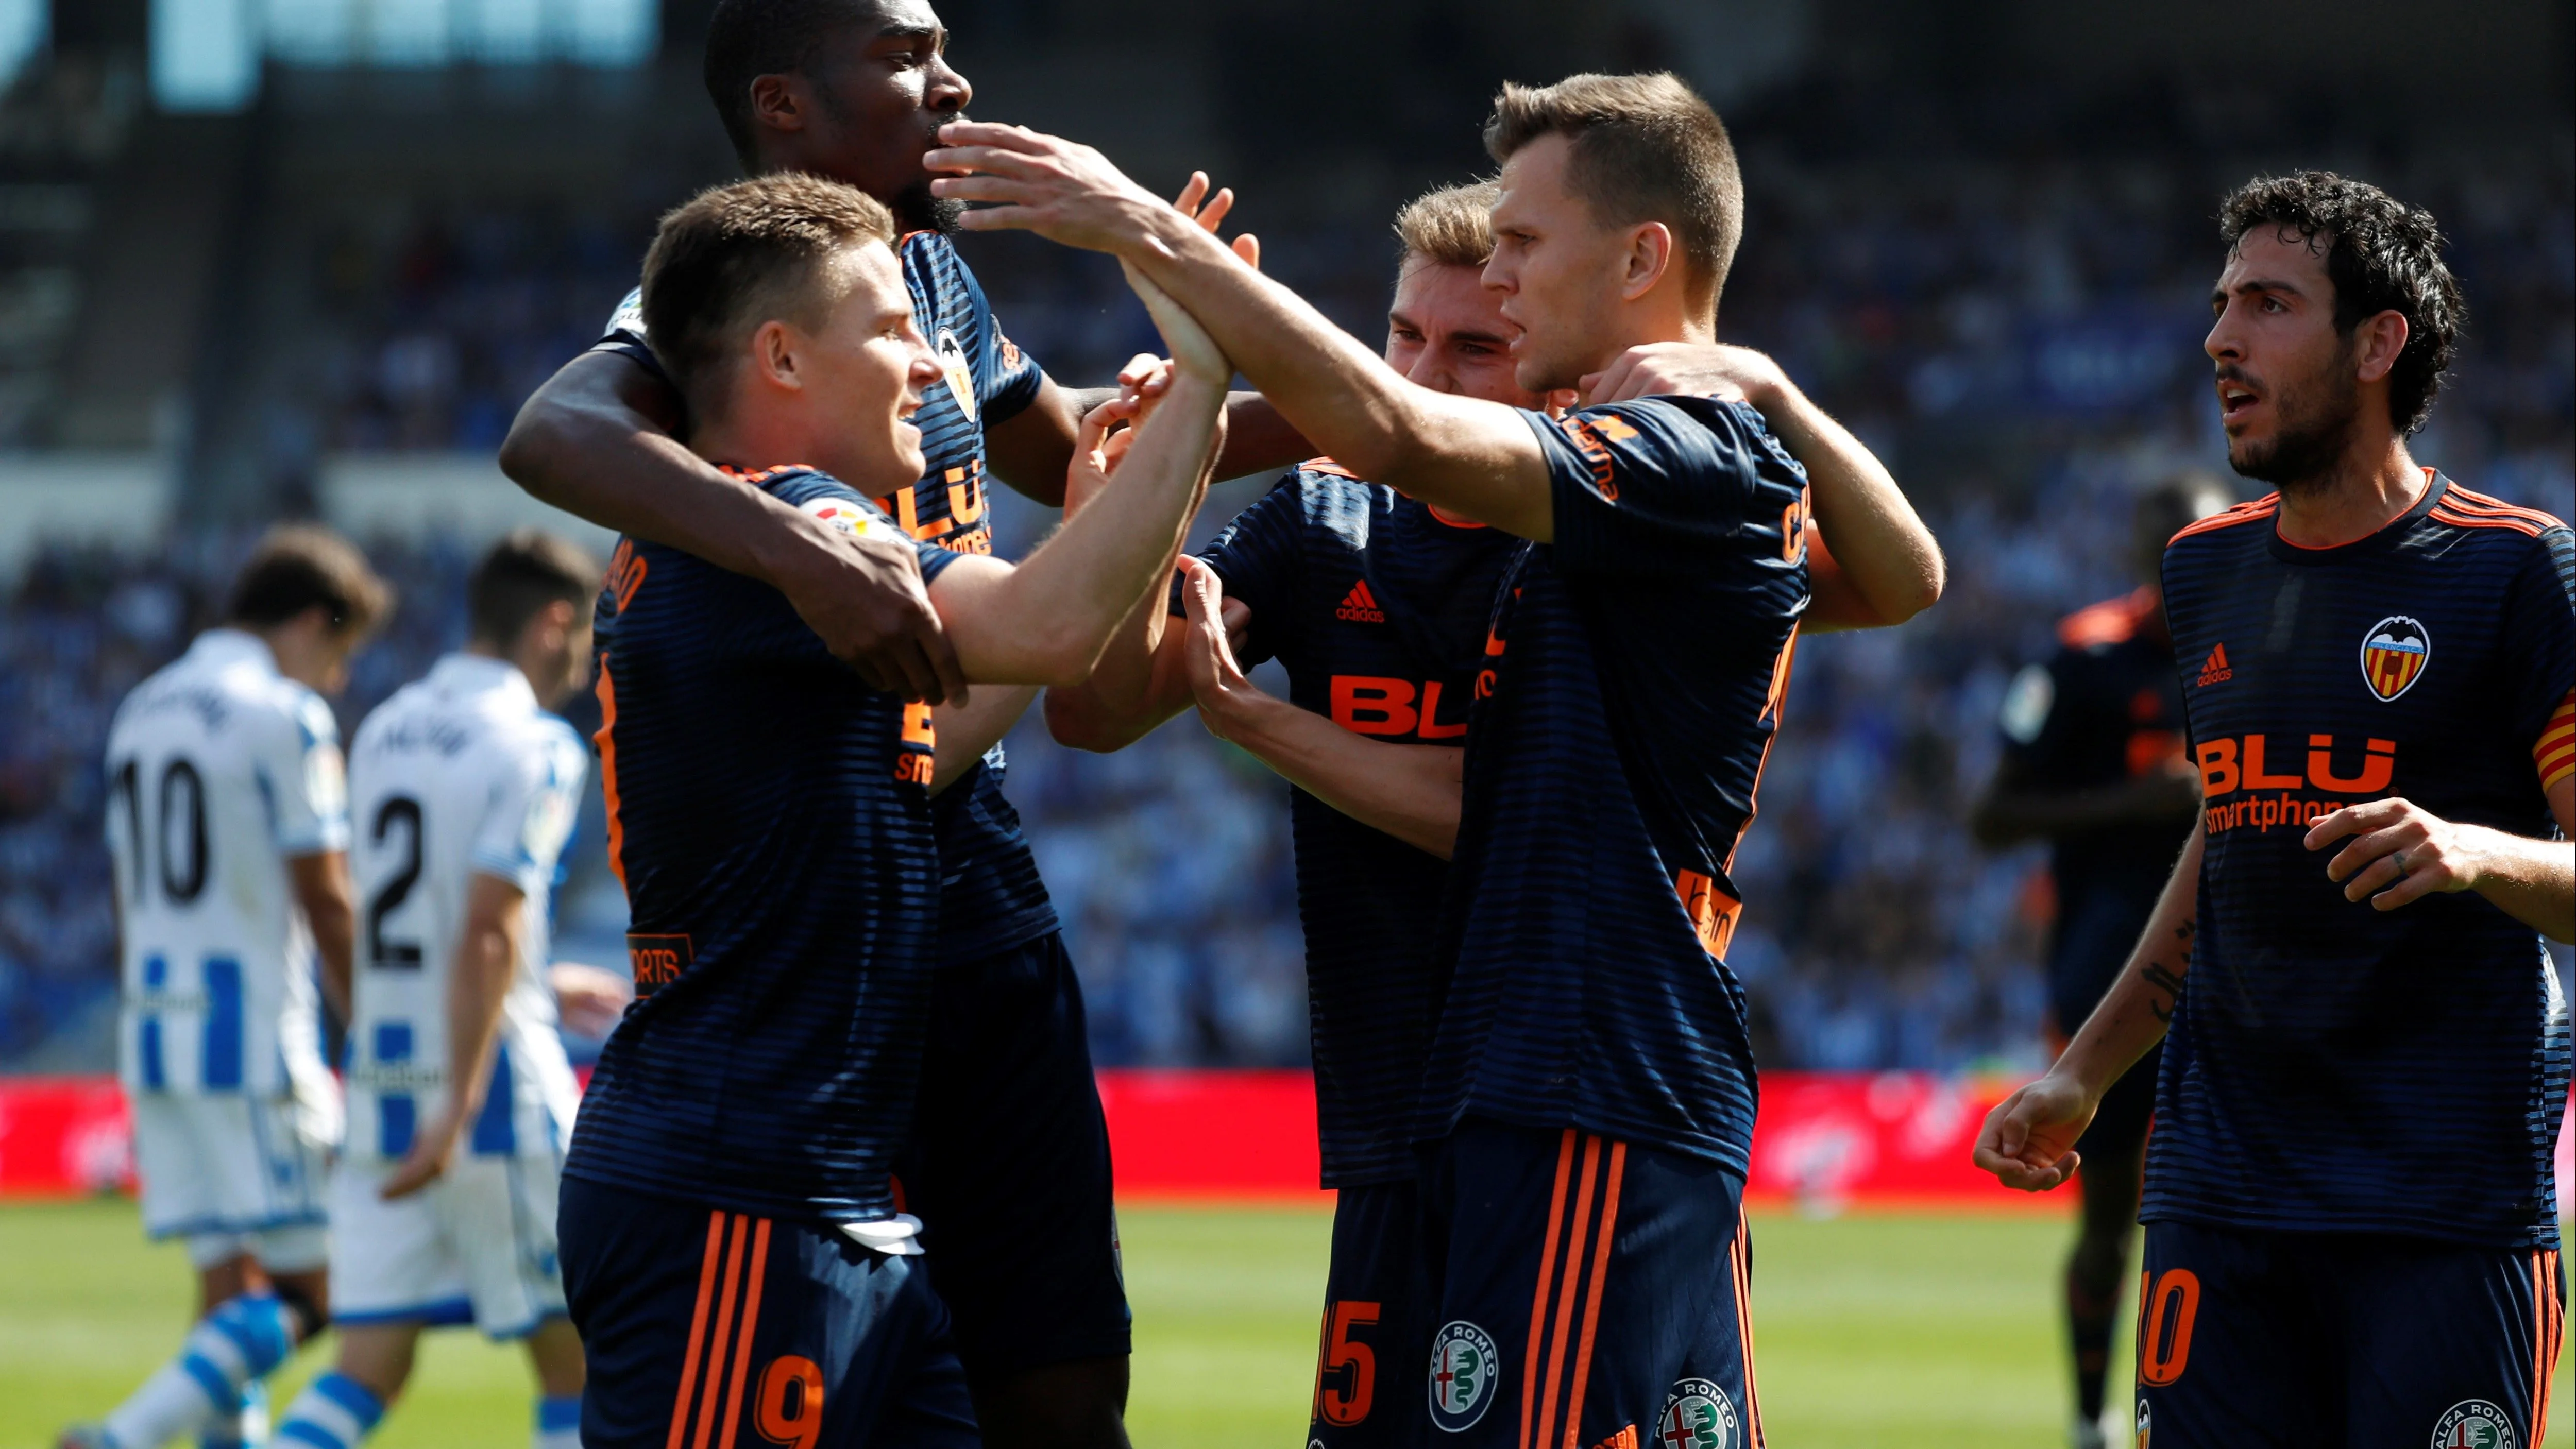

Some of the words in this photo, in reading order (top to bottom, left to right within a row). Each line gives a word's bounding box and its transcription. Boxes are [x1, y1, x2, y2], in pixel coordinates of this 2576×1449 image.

[1336, 606, 1385, 623] adidas
[2197, 669, 2232, 688] adidas
[1330, 675, 1468, 738] BL
[112, 758, 206, 906] 10
[2206, 792, 2362, 836] smartphon
[368, 797, 423, 969] 2
[1432, 1334, 1449, 1378] ALFA
[1454, 1326, 1495, 1377] ROMEO
[753, 1354, 825, 1449] 9
[1684, 1384, 1735, 1428] ROMEO
[2435, 1410, 2465, 1449] ALFA
[2471, 1404, 2512, 1449] ROMEO
